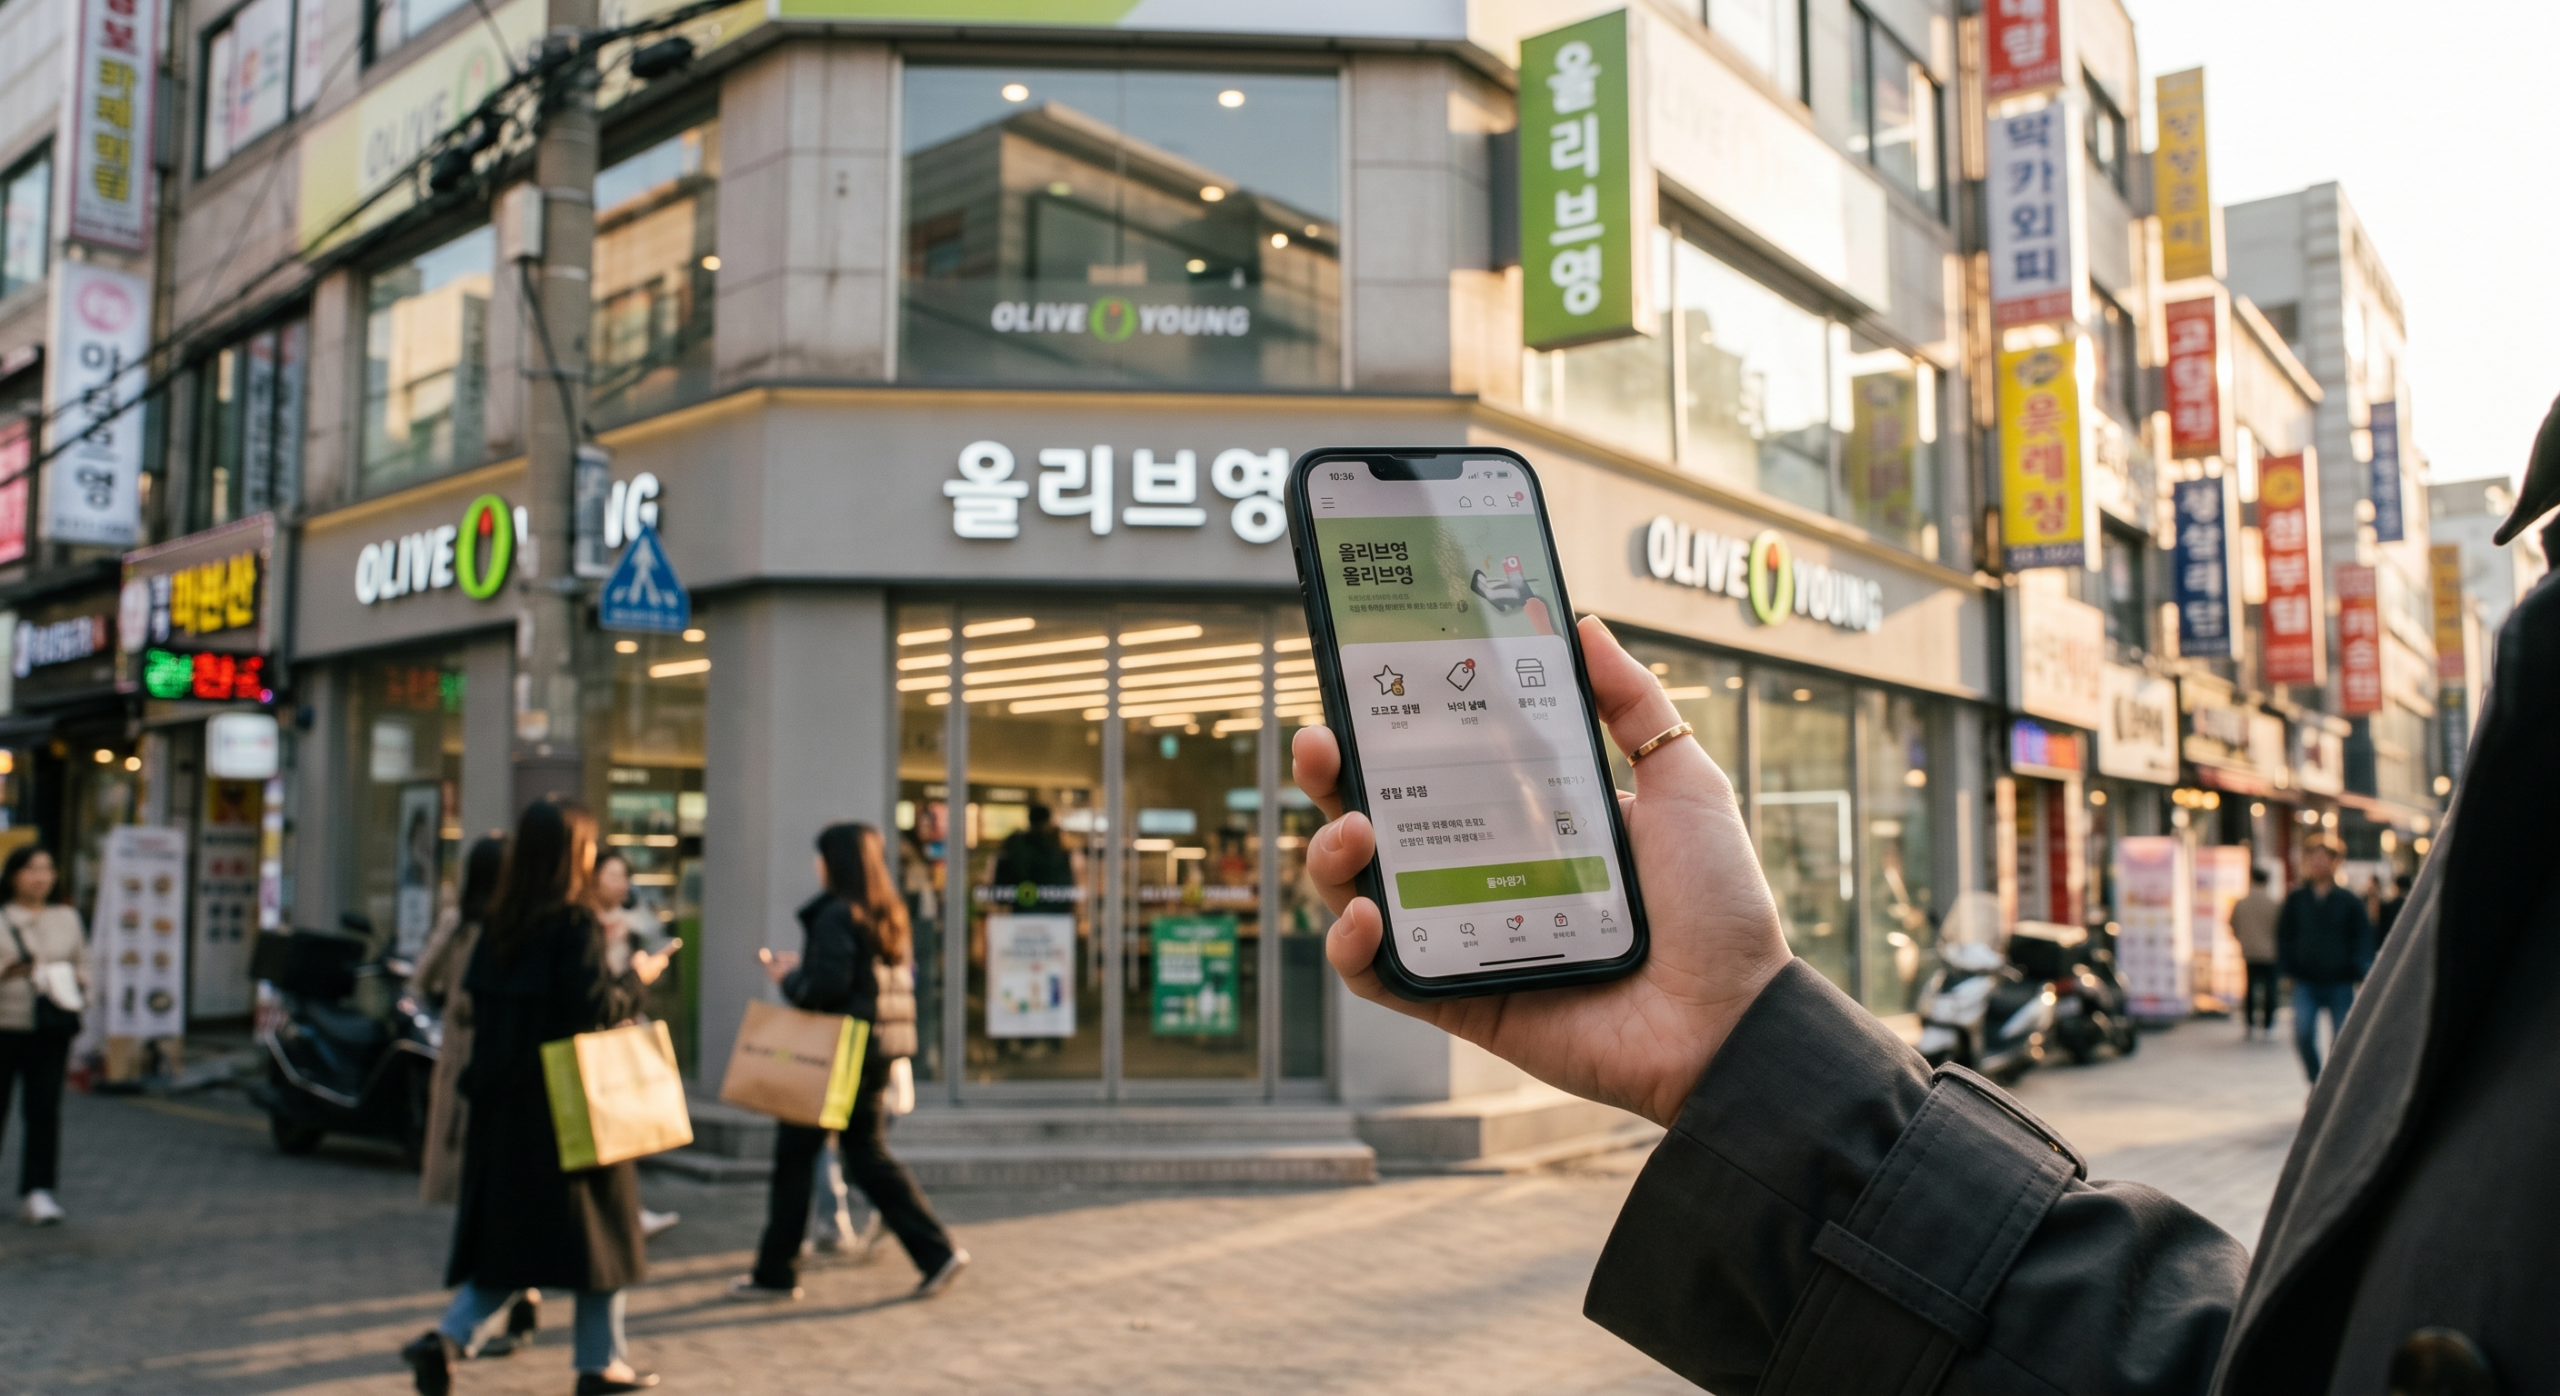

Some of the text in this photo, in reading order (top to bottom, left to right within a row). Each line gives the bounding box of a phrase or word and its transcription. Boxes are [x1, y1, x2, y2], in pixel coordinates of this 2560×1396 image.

[1546, 40, 1604, 316] 올리브영
[990, 300, 1251, 337] OLIVE YOUNG
[942, 440, 1290, 544] 올리브영
[1328, 472, 1355, 481] 10:36
[354, 523, 458, 605] OLIVE
[1338, 541, 1409, 562] 올리브영
[1342, 564, 1414, 586] 올리브영
[1647, 513, 1883, 634] OLIVE YOUNG
